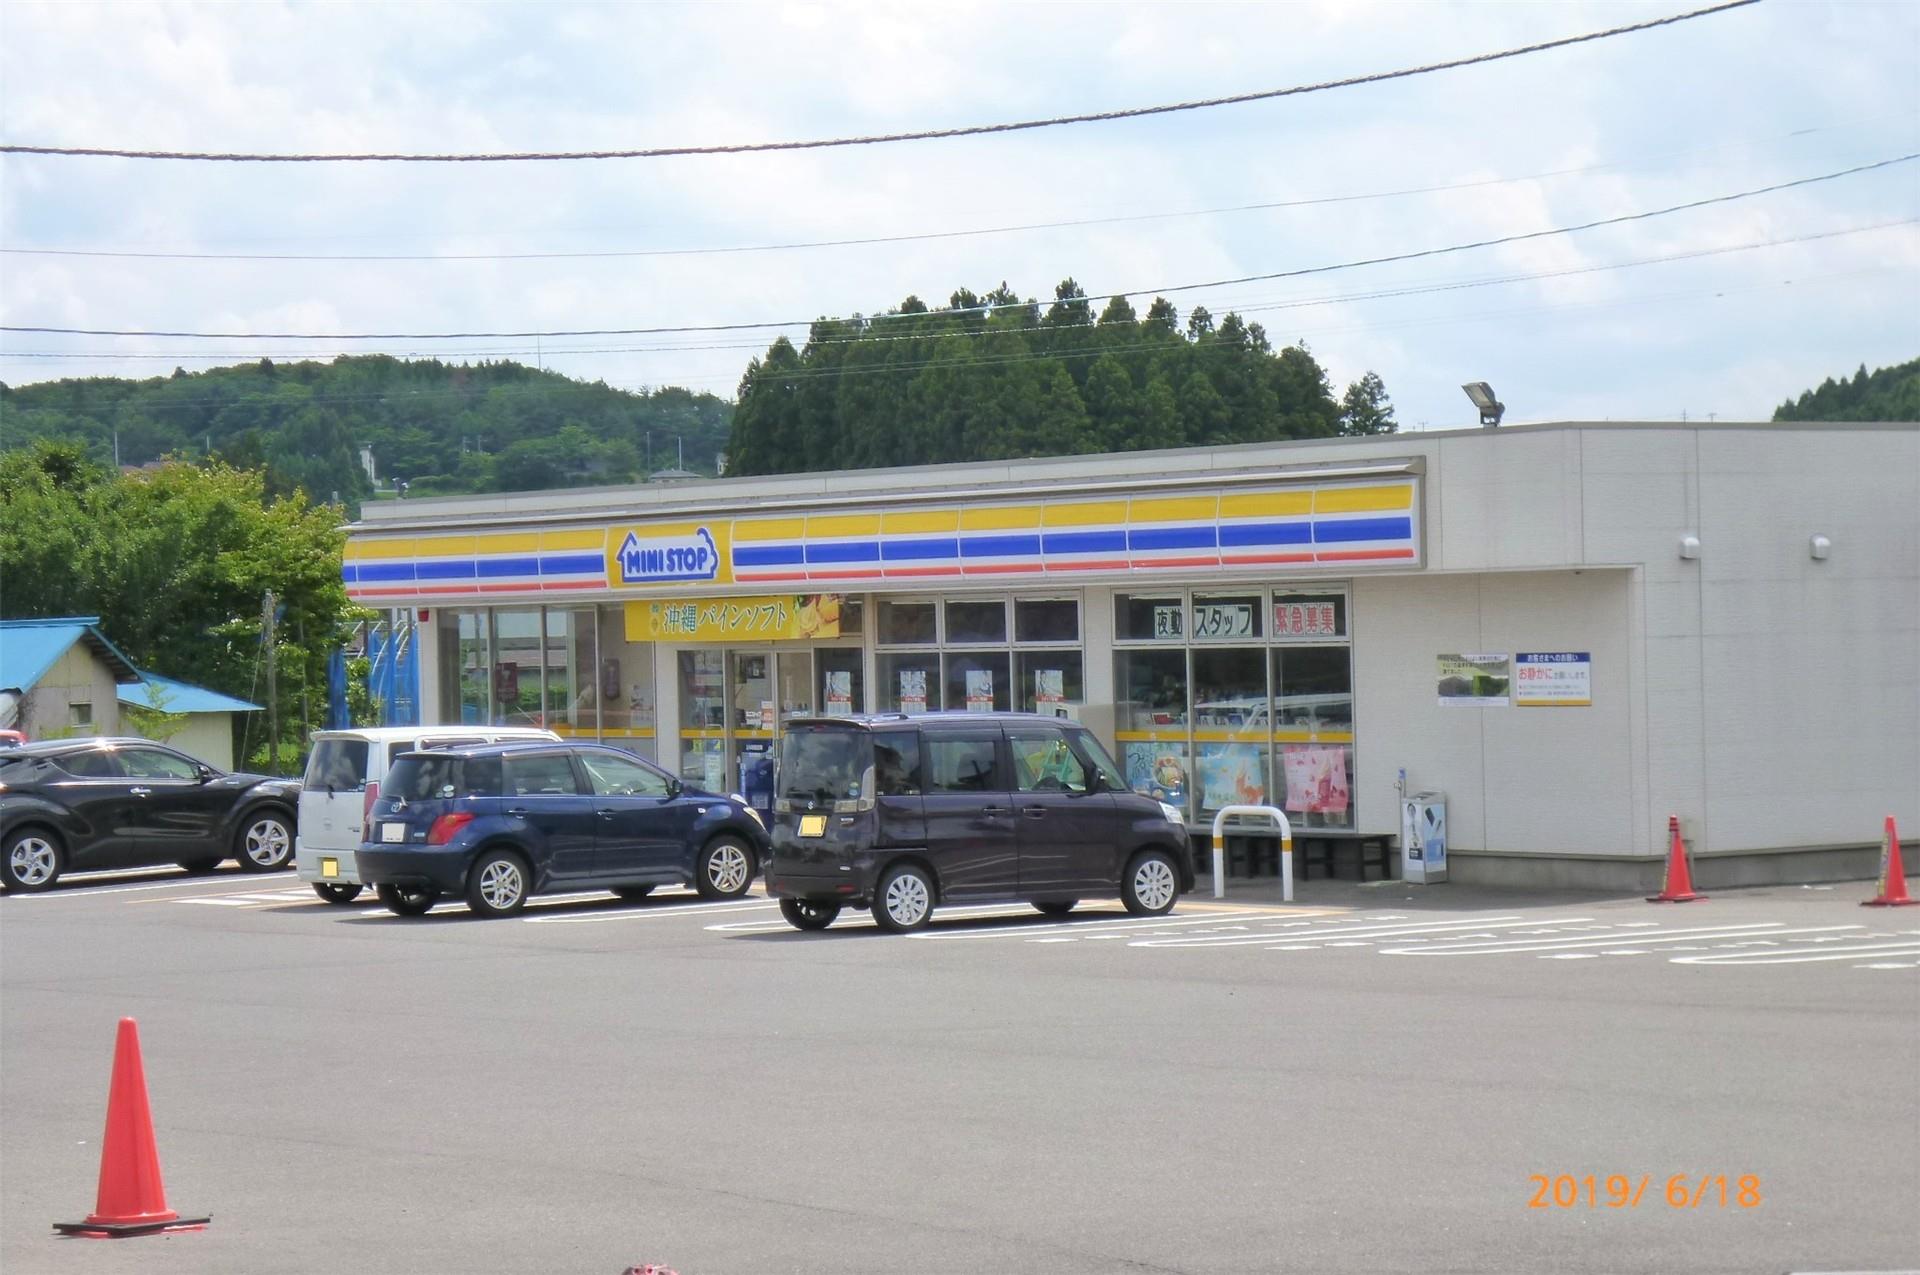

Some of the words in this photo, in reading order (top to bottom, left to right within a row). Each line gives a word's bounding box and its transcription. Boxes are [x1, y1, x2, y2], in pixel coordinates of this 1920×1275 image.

[627, 548, 664, 574] MINI
[666, 546, 708, 572] STOP
[663, 601, 787, 634] 沖縄パインソフト
[1195, 606, 1251, 636] スタッフ
[1276, 607, 1334, 634] 緊急募集
